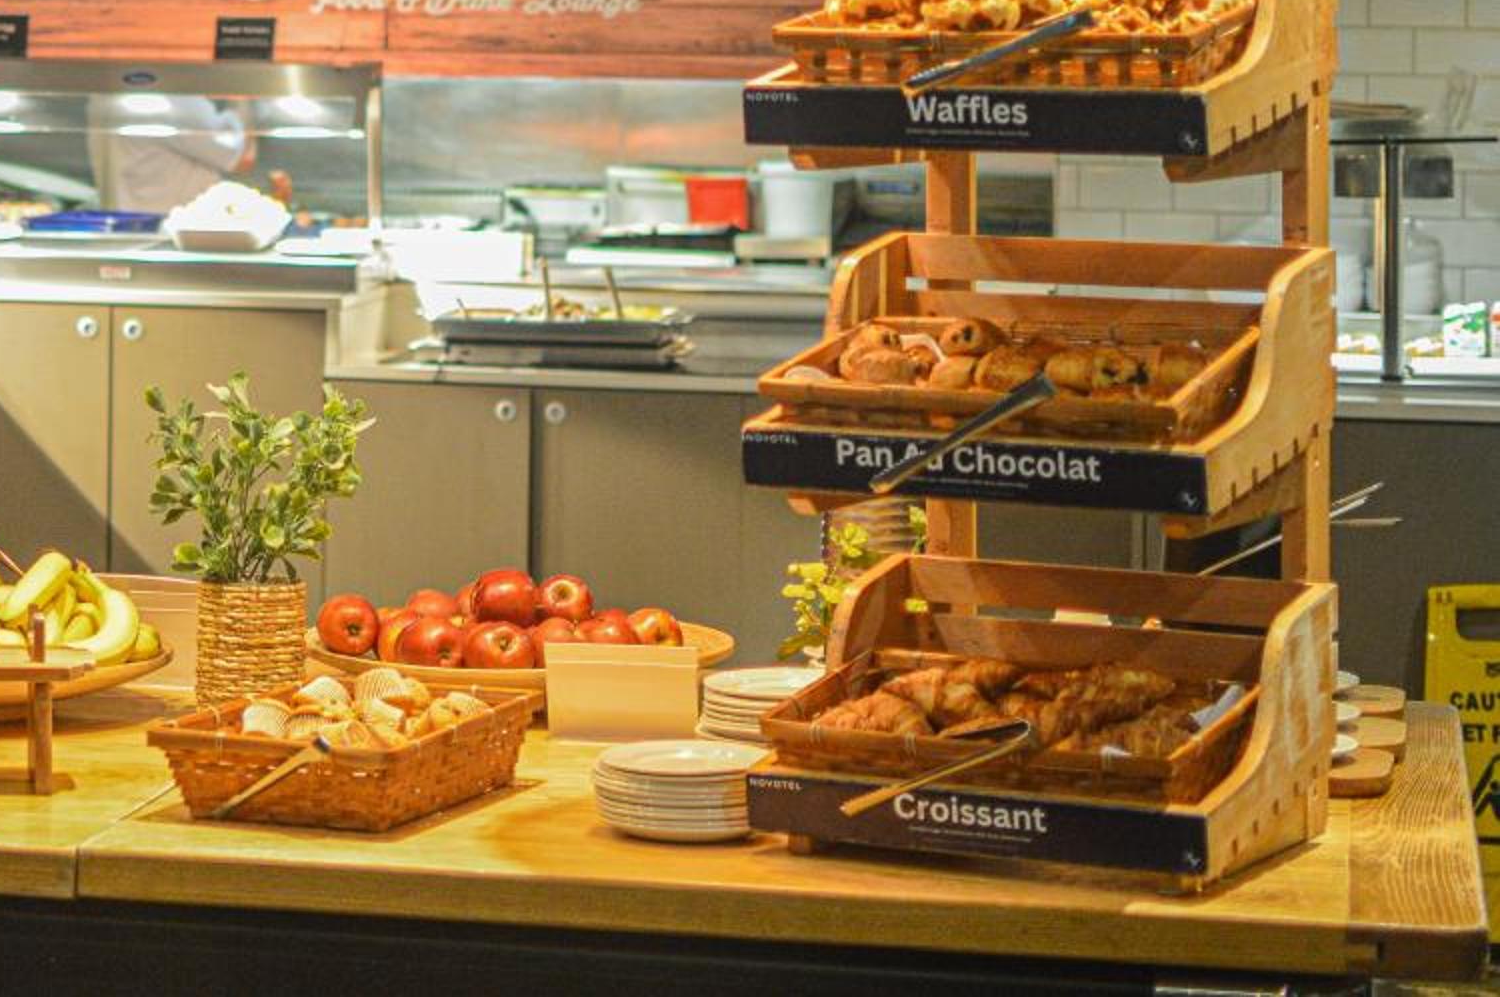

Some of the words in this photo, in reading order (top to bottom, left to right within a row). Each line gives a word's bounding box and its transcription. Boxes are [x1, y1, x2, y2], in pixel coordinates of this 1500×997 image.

[905, 93, 1029, 125] Waffles
[835, 439, 894, 469] Pan
[952, 445, 1102, 482] Chocolat
[749, 778, 804, 791] NOVOTEL
[893, 792, 1047, 834] Croissant
